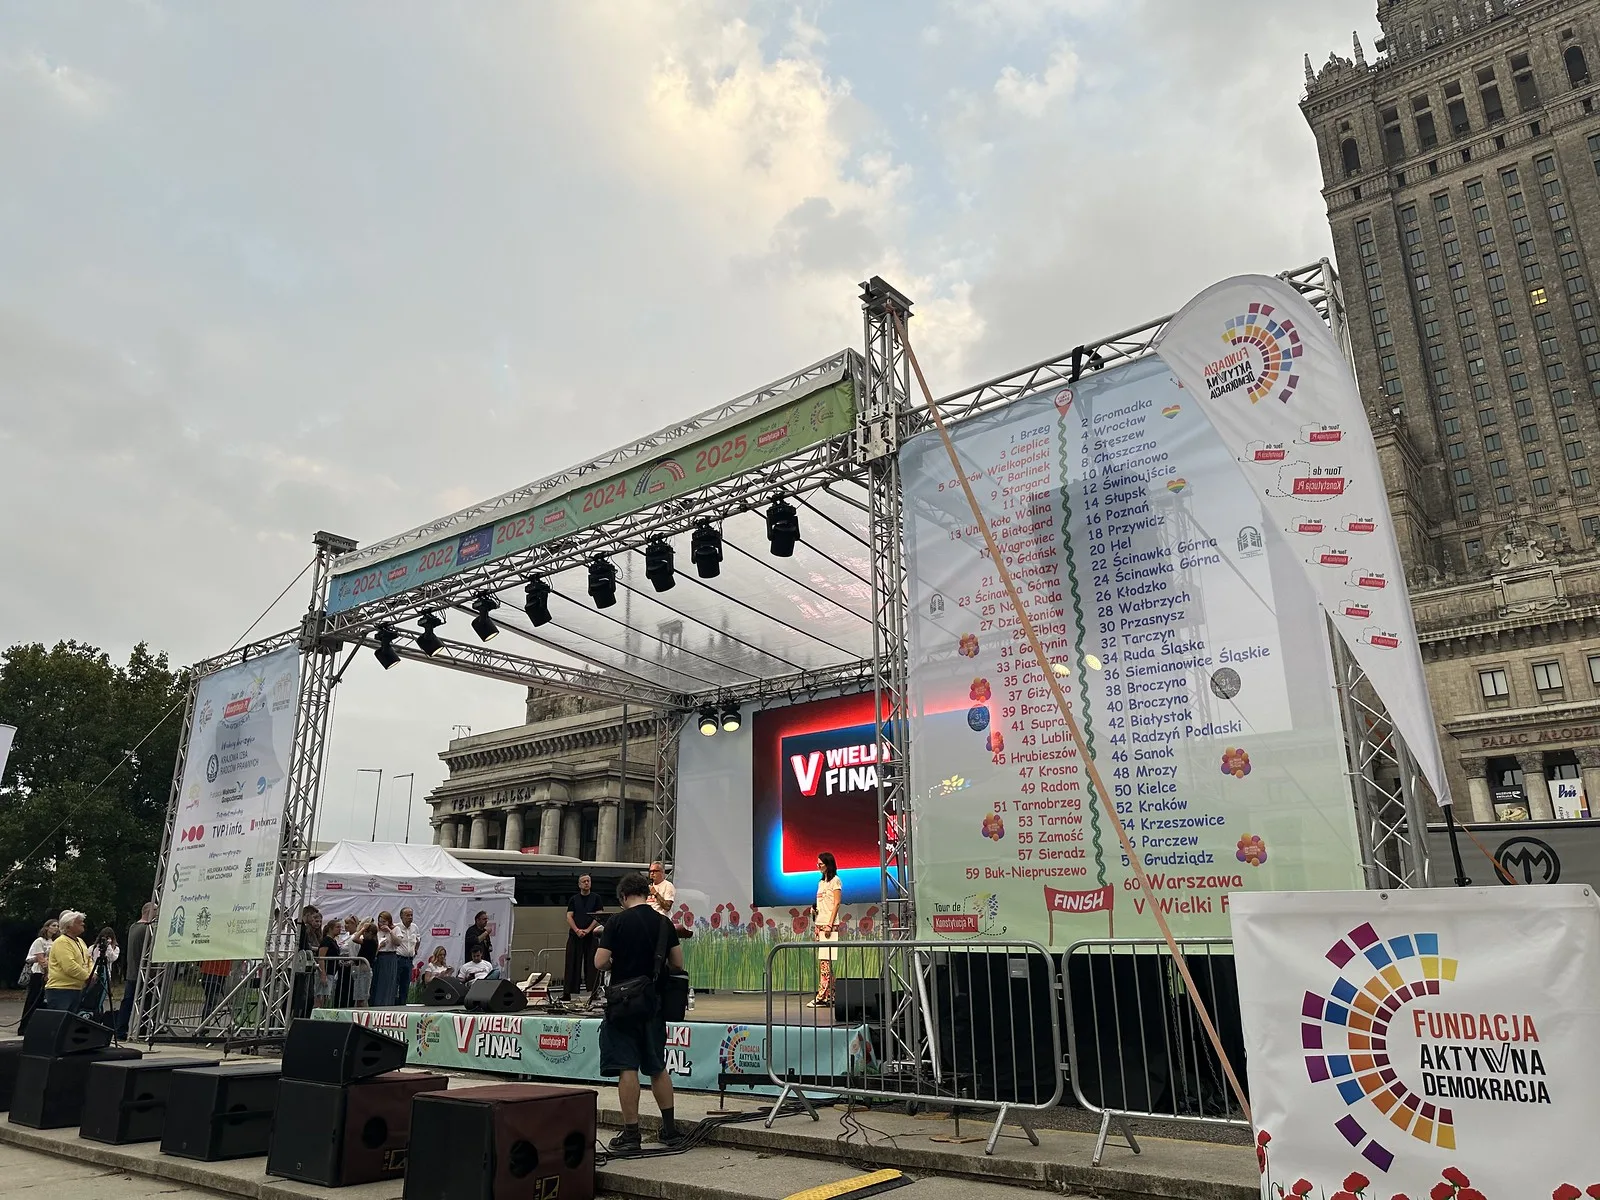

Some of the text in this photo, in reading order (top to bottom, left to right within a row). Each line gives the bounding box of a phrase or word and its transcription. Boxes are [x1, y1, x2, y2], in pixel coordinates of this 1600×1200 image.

[1081, 399, 1153, 428] 2 Gromadka
[1010, 424, 1051, 443] 1 Brzeg
[1081, 415, 1146, 440] 4 Wrocław
[1000, 437, 1050, 459] 3 Cieplice
[1081, 429, 1145, 454] 6 Stęszew
[695, 434, 748, 473] 2025
[1081, 440, 1157, 468] 8 Choszczno
[939, 448, 1050, 492] 5 Osrów Wielkopolski
[996, 462, 1051, 486] 7 Barlinek
[1082, 452, 1168, 481] 10 Marianowo
[991, 475, 1050, 501] 9 Stargard
[1083, 465, 1177, 496] 12 Świnoujście
[582, 479, 627, 513] 2024
[1003, 490, 1051, 510] 11 Police
[1085, 486, 1146, 510] 14 Słupsk
[1086, 500, 1149, 525] 16 Poznań
[496, 514, 536, 544] 2023
[1088, 514, 1165, 540] 18 Przywidz
[997, 533, 1055, 554] Wągrowiec
[1089, 537, 1132, 556] 20 Hel
[418, 545, 454, 573] 2022
[1018, 546, 1057, 564] Gdańsk
[1092, 538, 1218, 571] 22 Ścinawka Górna
[1094, 554, 1221, 587] 24 Ścinawka Górna
[353, 570, 382, 596] 2021
[1096, 580, 1167, 602] 26 Kłodzko
[1098, 591, 1191, 618] 28 Wałbrzych
[1012, 623, 1066, 640] 29 Elbląg
[1100, 610, 1185, 633] 30 Przasnysz
[1101, 628, 1175, 649] 32 Tarczyn
[1102, 639, 1205, 665] 34 Ruda Śląska
[1104, 645, 1271, 681] 36 Siemianowice Śląskie
[1105, 677, 1187, 697] 38 Broczyno
[1107, 693, 1189, 713] 40 Broczyno
[1108, 708, 1193, 729] 42 Białystok
[1022, 735, 1036, 746] 43
[1110, 720, 1242, 746] 44 Radzyń Podlaski
[1482, 733, 1528, 748] PAŁAC
[992, 746, 1077, 765] 45 Hrubieszów
[1111, 745, 1175, 762] 46 Sanok
[790, 750, 825, 797] V
[1019, 765, 1078, 778] 47 Krosno
[1113, 765, 1178, 779] 48 Mrozy
[1021, 780, 1080, 794] 49 Radom
[1115, 781, 1177, 797] 50 Kielce
[994, 798, 1081, 813] 51 Tarnobrzeg
[1116, 797, 1188, 814] 52 Kraków
[1019, 812, 1082, 827] 53 Tarnów
[1120, 814, 1226, 831] 54 Krzeszowice
[1018, 828, 1084, 844] 55 Zamość
[1142, 835, 1199, 848] Parczew
[1018, 846, 1086, 861] 57 Sieradz
[1144, 850, 1214, 866] Grudziądz
[965, 865, 1087, 880] 59 Buk-Niepruszewo
[1123, 873, 1243, 891] 60 Warszawa
[934, 902, 961, 912] Tour de
[1054, 890, 1104, 911] FINISH
[1133, 897, 1145, 915] V
[1155, 896, 1212, 915] Wielki
[935, 918, 975, 930] Konstytucja PL
[372, 1012, 408, 1029] WIELKI
[543, 1023, 559, 1033] Tour de
[1413, 1009, 1539, 1042] FUNDACJA
[453, 1015, 475, 1053] V
[478, 1016, 522, 1035] WIELKI
[1420, 1043, 1546, 1075] AKTYWNA
[1422, 1072, 1551, 1104] DEMOKRACJA
